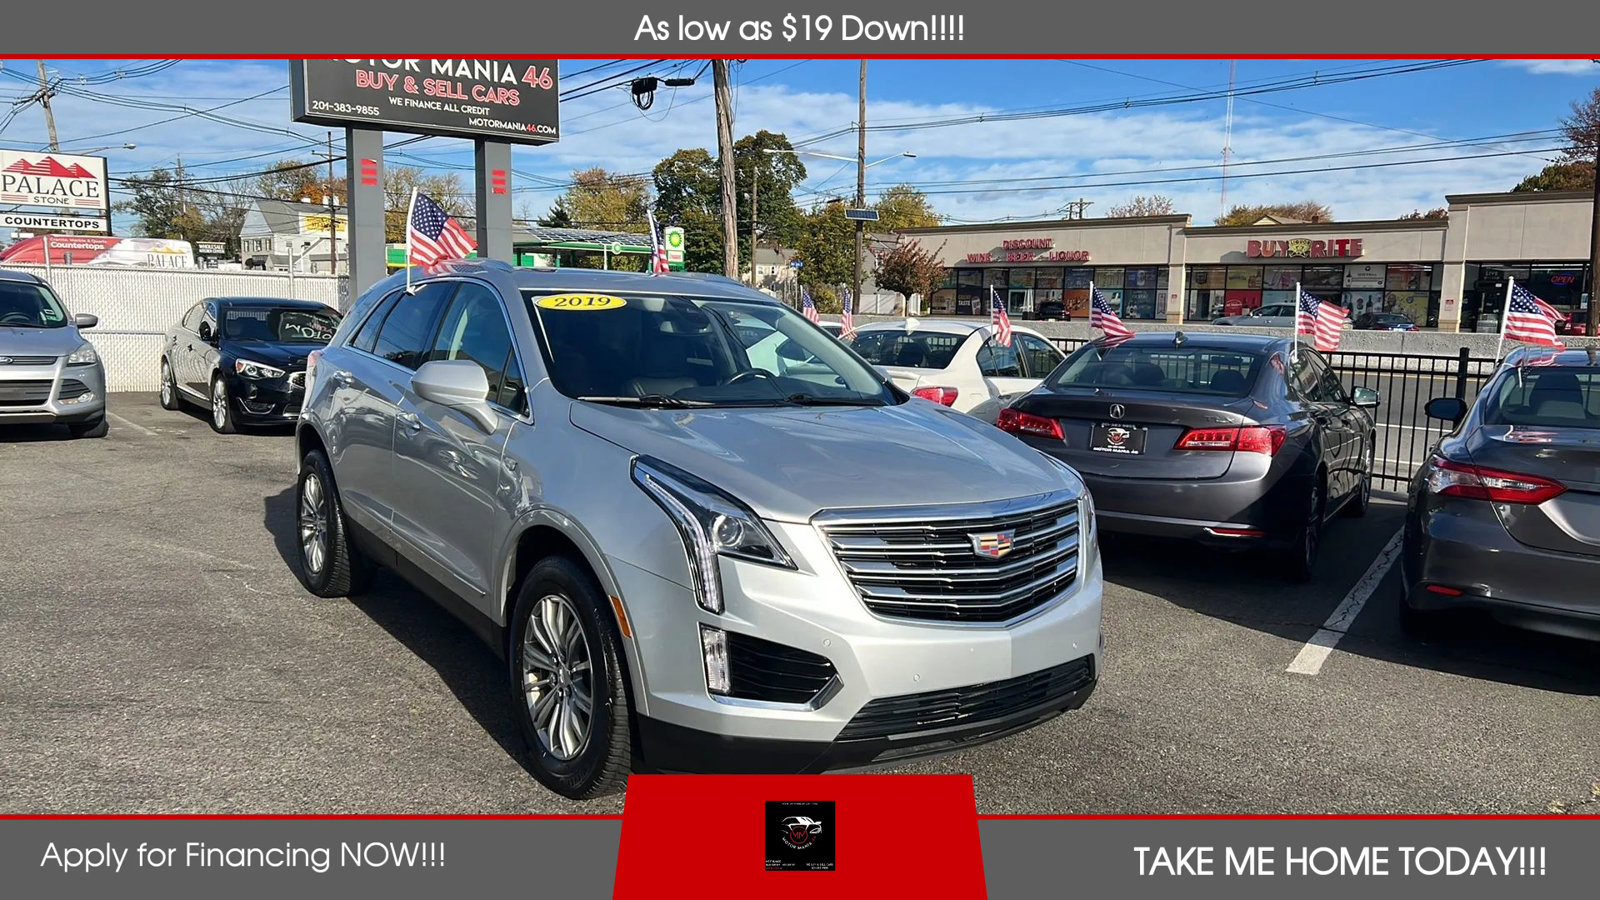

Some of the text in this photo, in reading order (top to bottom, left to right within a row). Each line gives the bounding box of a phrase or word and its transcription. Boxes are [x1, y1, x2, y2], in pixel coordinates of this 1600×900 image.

[431, 59, 518, 85] MANIA
[521, 65, 554, 89] 46
[356, 70, 520, 106] BUY & SELL CARS
[312, 100, 380, 116] 201-383-9855
[388, 97, 491, 116] WE FINANCE ALL CREDIT
[468, 117, 557, 135] MOTORMANIA46.COM
[1, 172, 100, 198] PALACE
[33, 196, 70, 205] STONE
[4, 216, 100, 229] COUNTERTOPS
[50, 241, 104, 251] Countertops
[1002, 238, 1053, 250] DISCOUNT
[1246, 238, 1362, 258] BUY RITE
[966, 252, 993, 263] WINE
[1048, 250, 1089, 262] LIQUOR
[1550, 276, 1575, 284] OPEN
[554, 296, 611, 307] 2019
